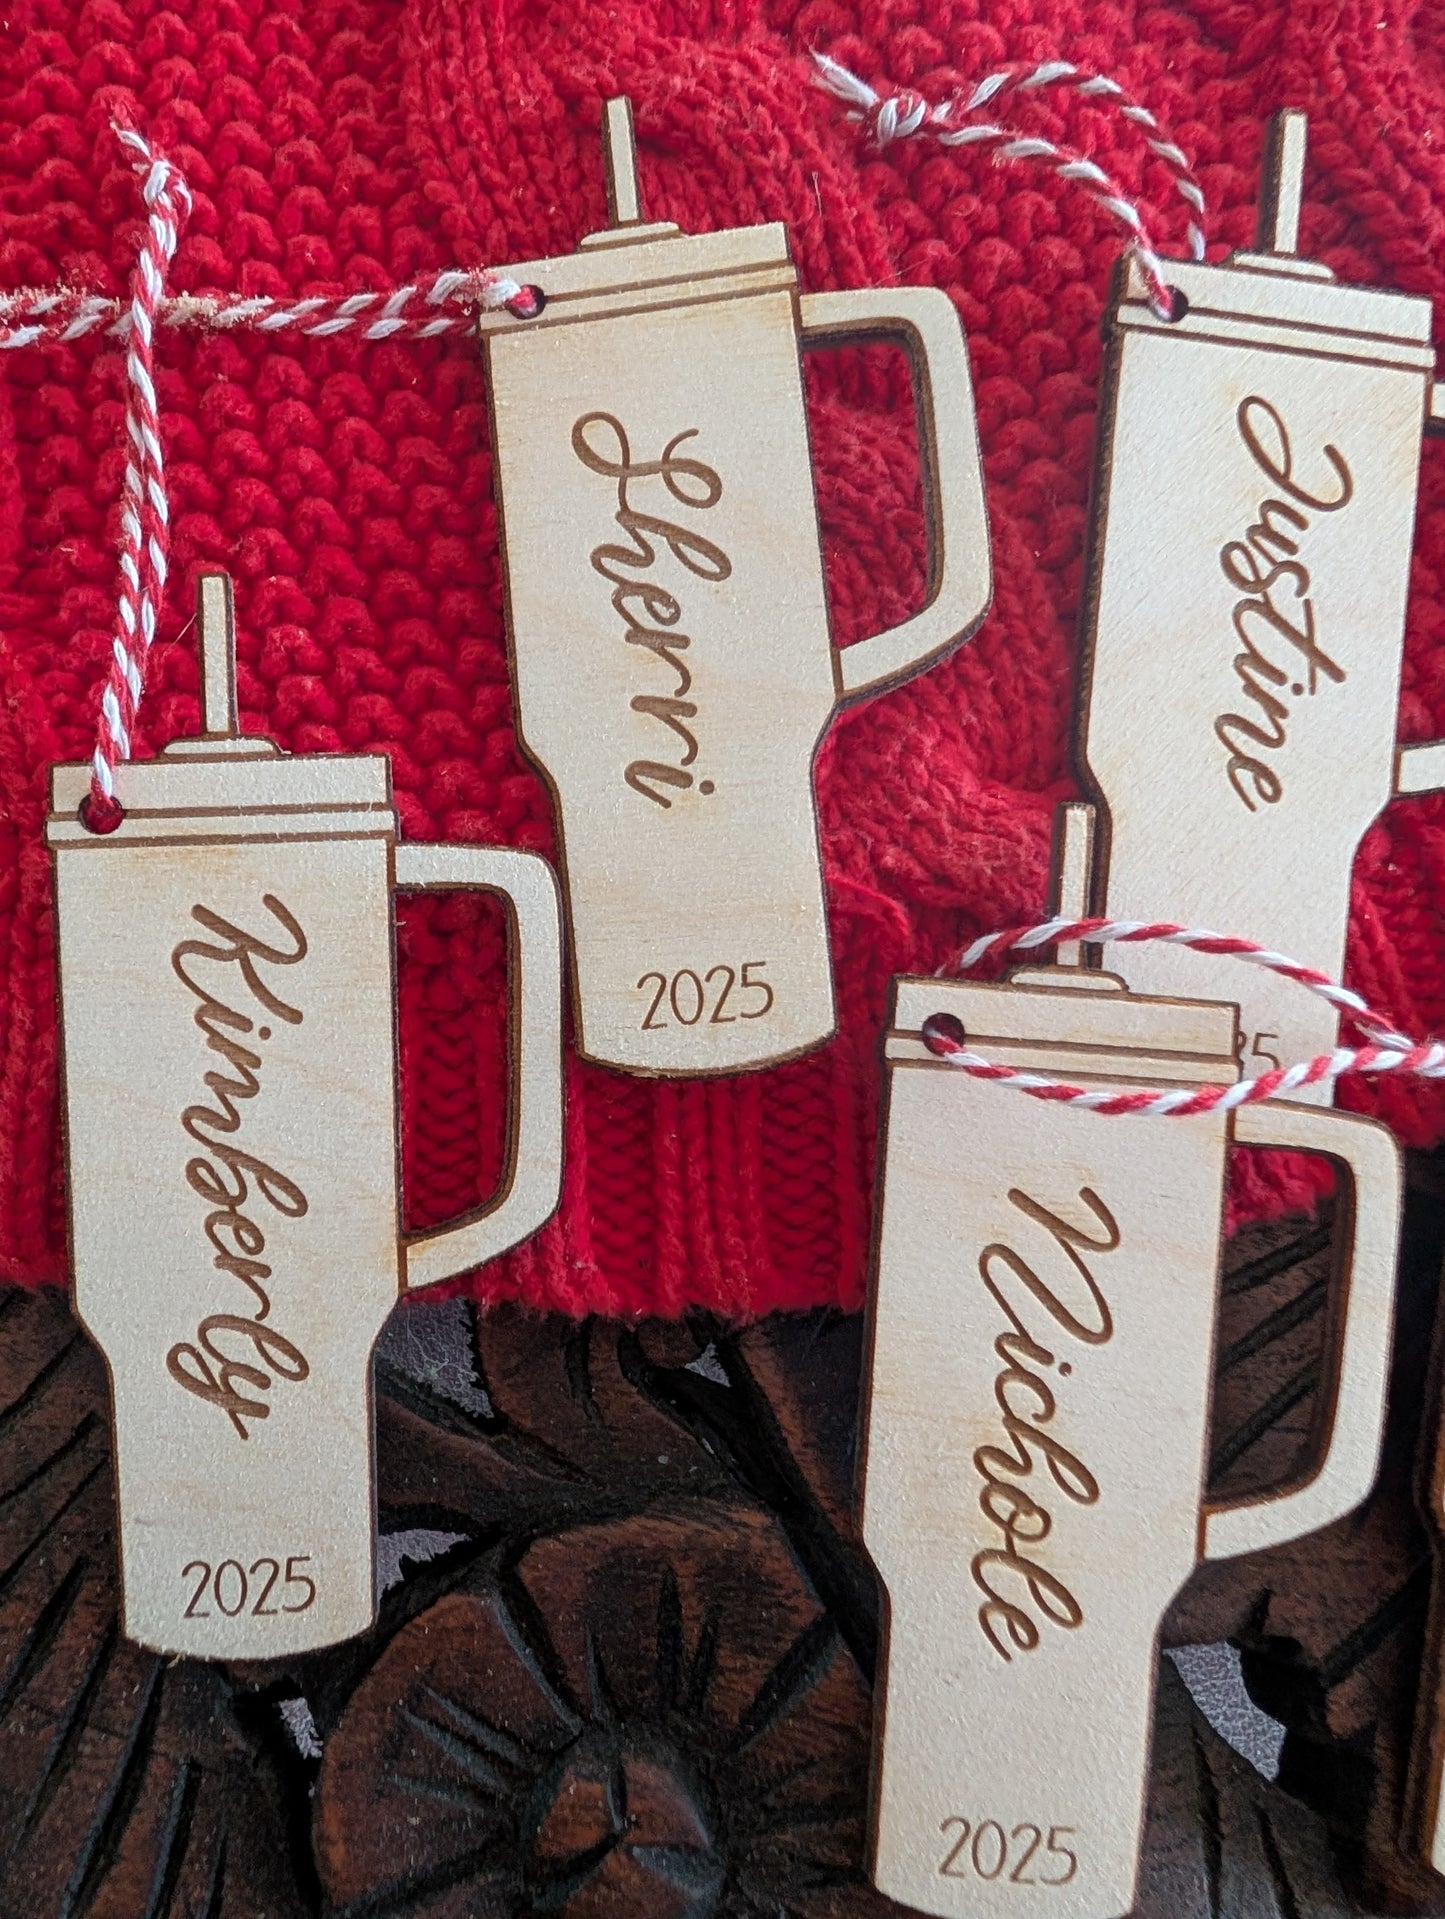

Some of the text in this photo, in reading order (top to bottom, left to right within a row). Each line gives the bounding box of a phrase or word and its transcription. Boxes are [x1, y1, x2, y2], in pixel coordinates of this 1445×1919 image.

[571, 410, 732, 809] Sherri
[1213, 395, 1354, 813] Justine
[165, 893, 309, 1441] Kimberly
[636, 961, 774, 1031] 2025
[180, 1556, 317, 1619] 2025
[971, 1187, 1121, 1663] Nichole
[939, 1816, 1078, 1886] 2025
